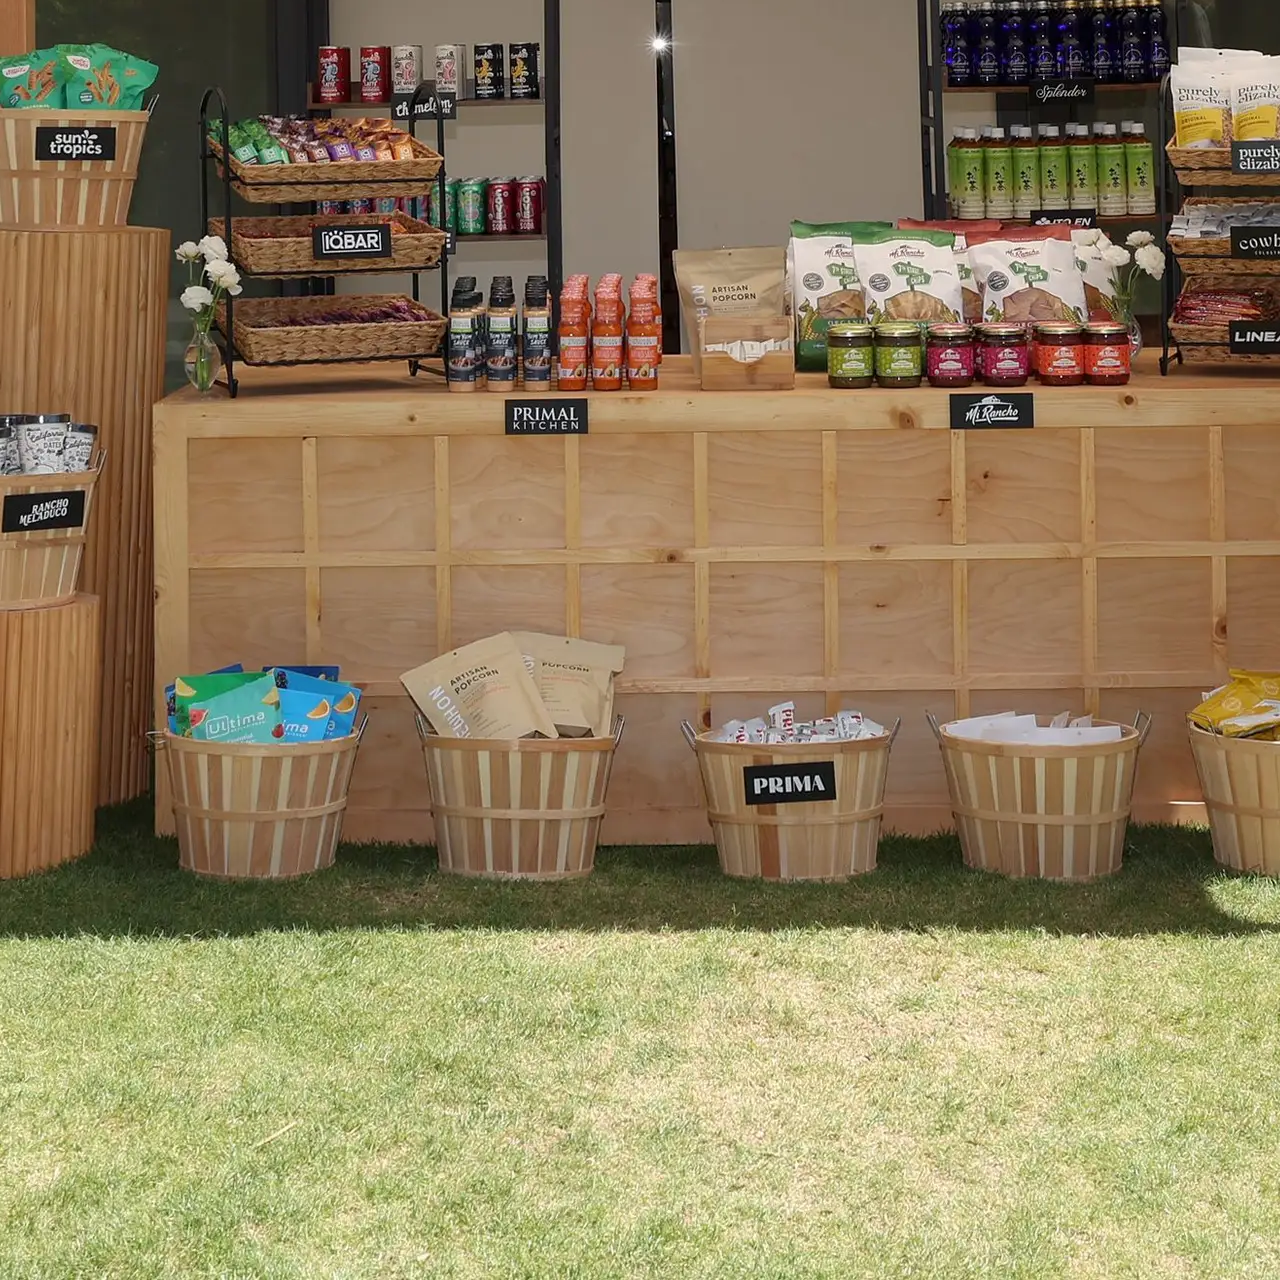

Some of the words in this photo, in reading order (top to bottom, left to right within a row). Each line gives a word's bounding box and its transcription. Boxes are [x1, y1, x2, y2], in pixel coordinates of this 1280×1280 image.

[1036, 83, 1087, 102] Splendor
[1237, 83, 1280, 97] purely
[1178, 94, 1229, 106] elizabet
[55, 133, 81, 144] sun
[50, 142, 102, 158] tropics
[324, 232, 380, 251] IQBAR
[712, 284, 748, 293] ARTISAN
[713, 293, 756, 302] POPCORN
[513, 407, 578, 421] PRIMAL
[965, 405, 980, 425] Mi
[982, 405, 1018, 424] Rancho
[513, 421, 579, 430] KITCHEN
[30, 427, 65, 442] California
[32, 498, 69, 514] RANCHO
[19, 507, 68, 526] MELADUCO
[449, 665, 488, 686] ARTISAN
[454, 669, 499, 695] POPCORN
[753, 774, 826, 795] PRIMA
